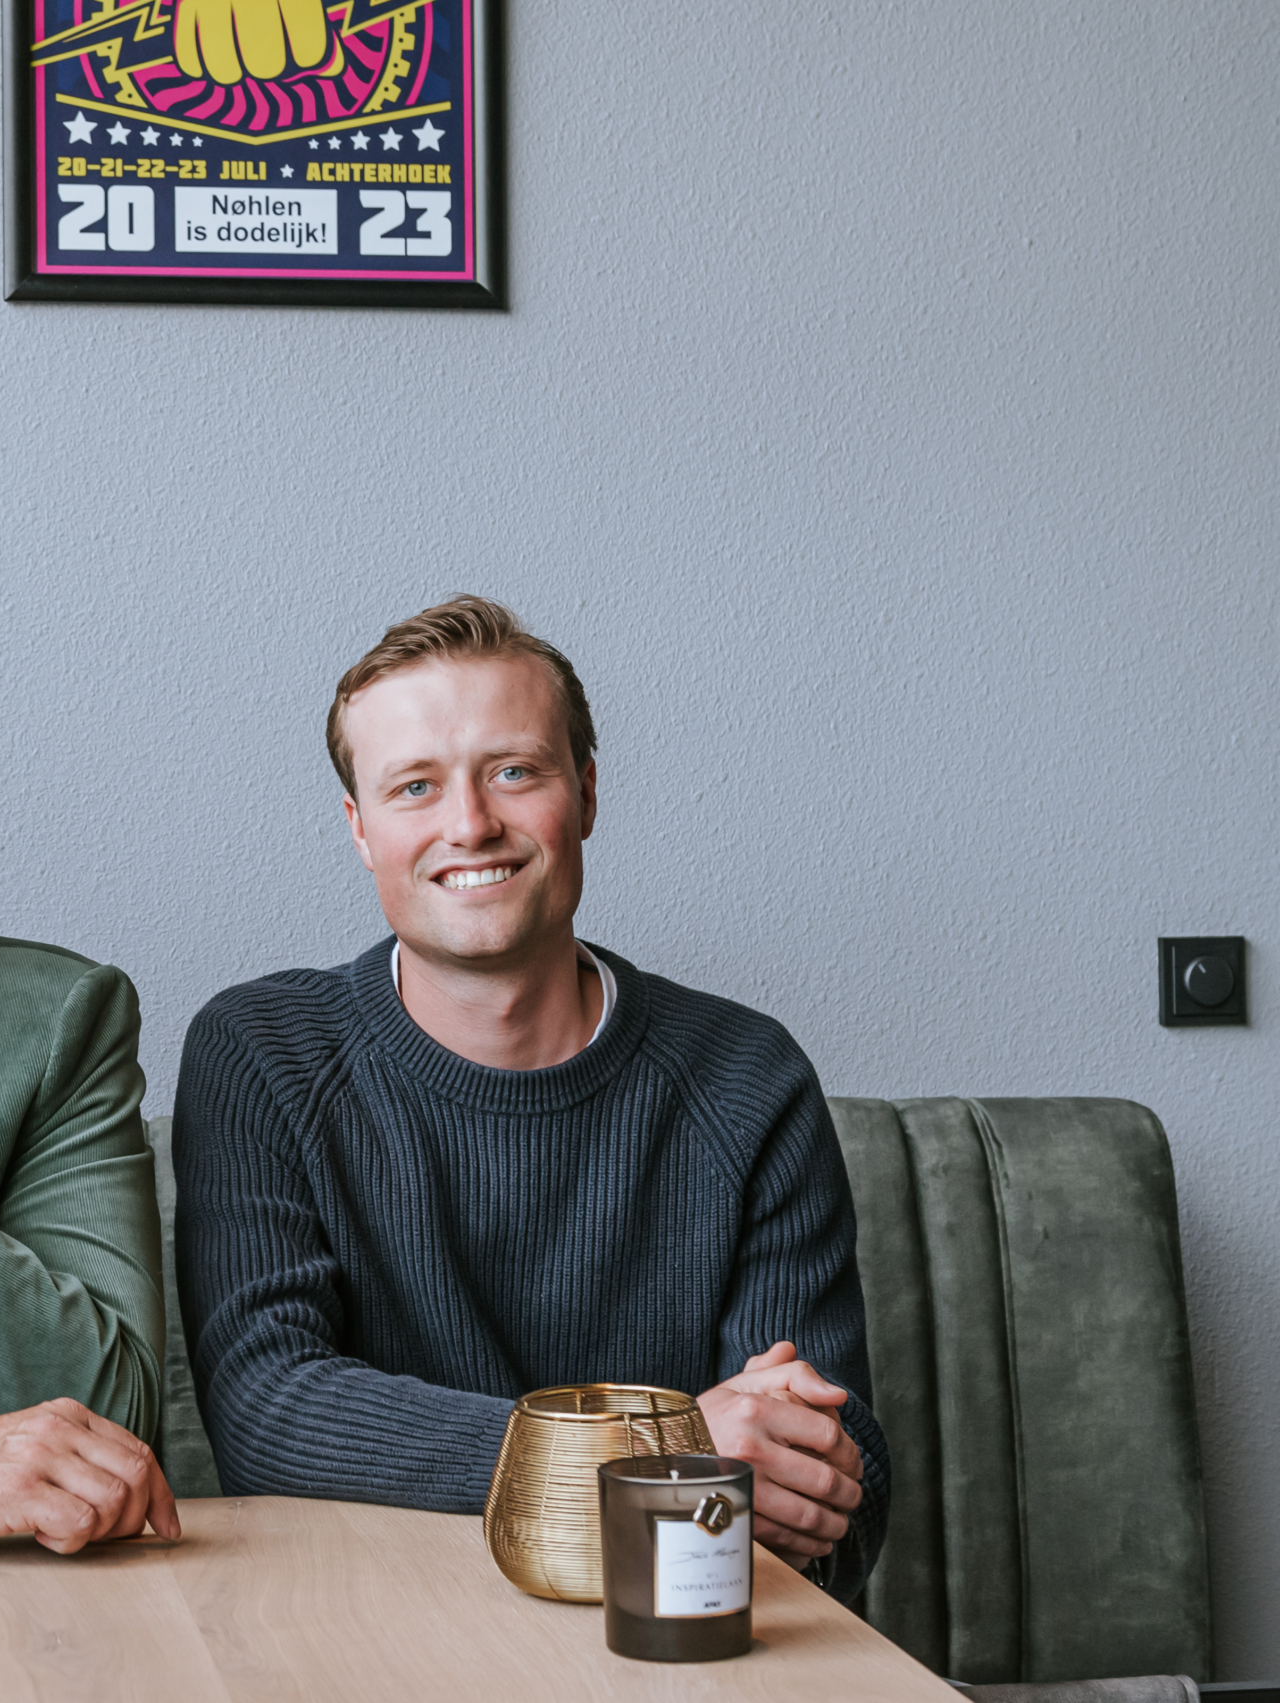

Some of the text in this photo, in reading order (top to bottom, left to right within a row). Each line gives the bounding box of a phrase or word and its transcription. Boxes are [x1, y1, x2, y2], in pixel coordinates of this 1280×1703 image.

[57, 156, 453, 185] 20-21-22-23 JULI ACHTERHOEK
[57, 183, 156, 252] 20
[211, 194, 303, 217] Nøhlen
[186, 220, 327, 249] is dodelijk!
[358, 188, 453, 258] 23
